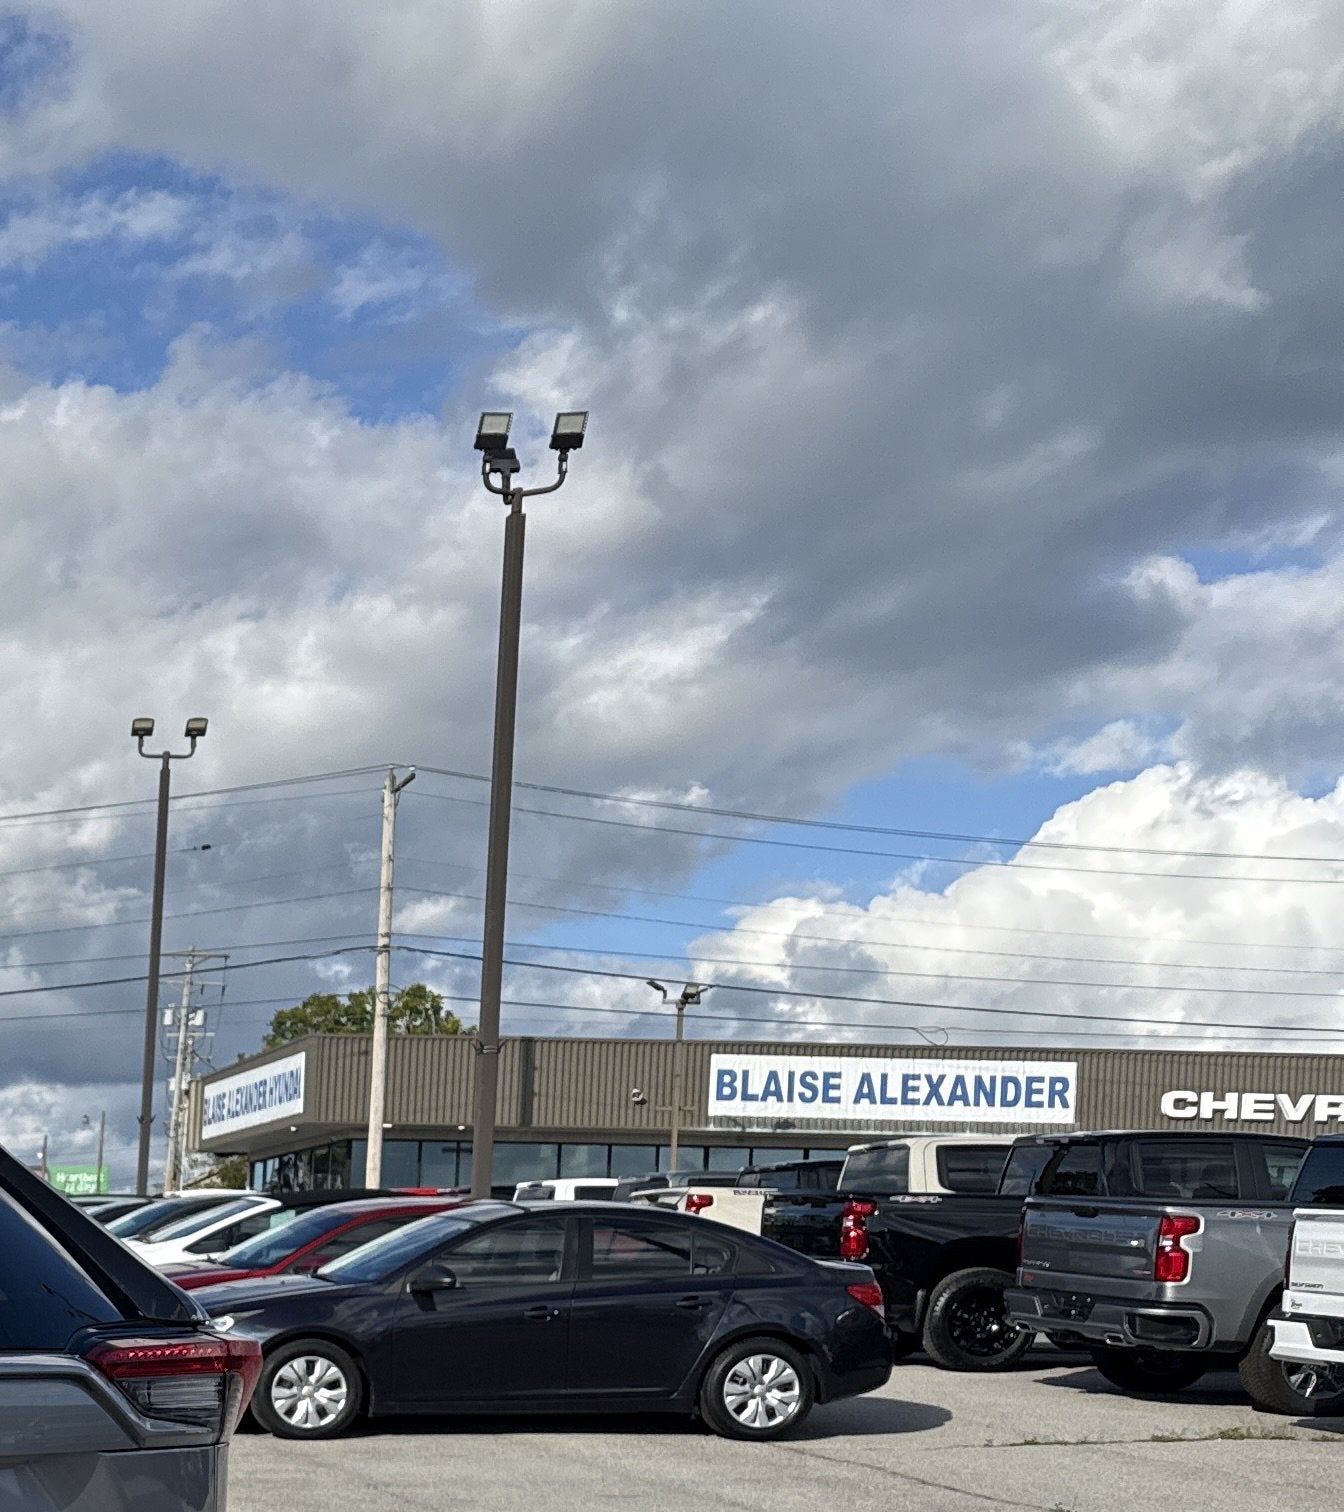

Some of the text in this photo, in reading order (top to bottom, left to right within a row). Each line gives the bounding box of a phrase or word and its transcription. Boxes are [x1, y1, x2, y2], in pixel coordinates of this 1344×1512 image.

[227, 1078, 268, 1120] ALEXANDER
[268, 1067, 301, 1108] HYUNDAI
[716, 1068, 1071, 1109] BLAISE ALEXANDER
